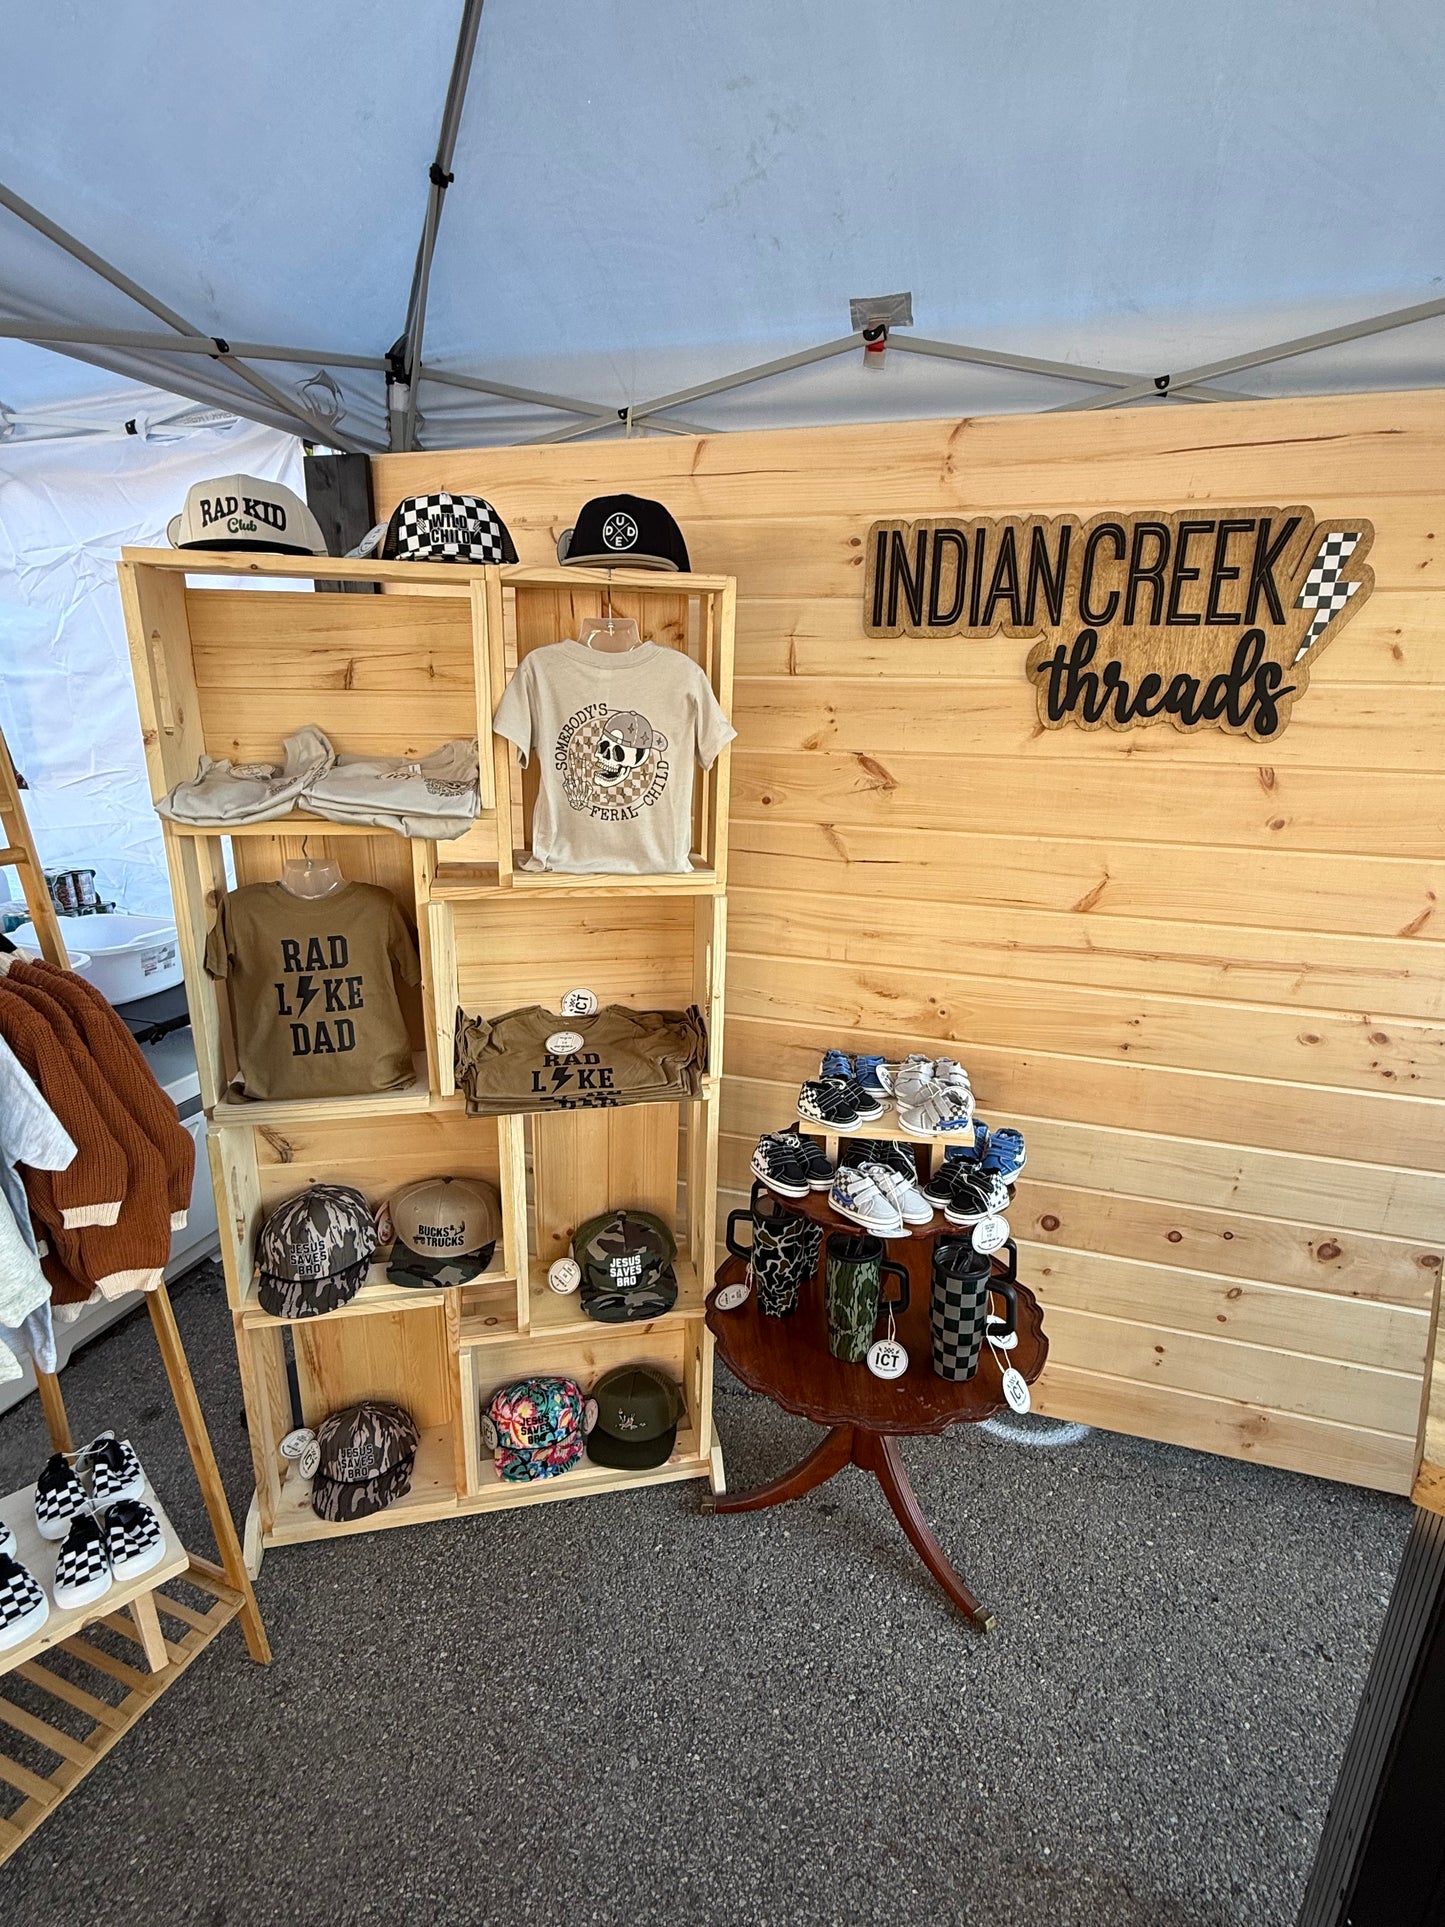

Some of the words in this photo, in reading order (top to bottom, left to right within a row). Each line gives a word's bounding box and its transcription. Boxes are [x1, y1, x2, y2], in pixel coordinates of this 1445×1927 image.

[200, 496, 239, 527] RAD
[242, 497, 287, 531] KID
[431, 512, 468, 529] WILD
[227, 517, 257, 533] Club
[430, 528, 472, 545] CHILD
[872, 525, 1073, 627] INDIAN
[1079, 517, 1303, 627] CREEK
[1038, 629, 1296, 737] threads
[555, 703, 608, 771] SOMEBODY'S
[643, 760, 670, 806] CHILD
[590, 806, 639, 822] FERAL
[281, 934, 349, 973] RAD
[574, 994, 589, 1015] ICT
[290, 1018, 356, 1056] DAD
[543, 1053, 601, 1068] RAD
[418, 1224, 450, 1237] BUCKS
[290, 1240, 325, 1254] JESUS
[426, 1235, 465, 1247] TRUCKS
[290, 1251, 327, 1265] SAVES
[610, 1255, 641, 1268] JESUS
[298, 1265, 321, 1275] BRO
[610, 1264, 642, 1278] SAVES
[616, 1276, 637, 1287] BRO
[875, 1352, 900, 1368] ICT
[341, 1445, 373, 1458] JESUS
[341, 1455, 375, 1469] SAVES
[348, 1467, 368, 1478] BRO
